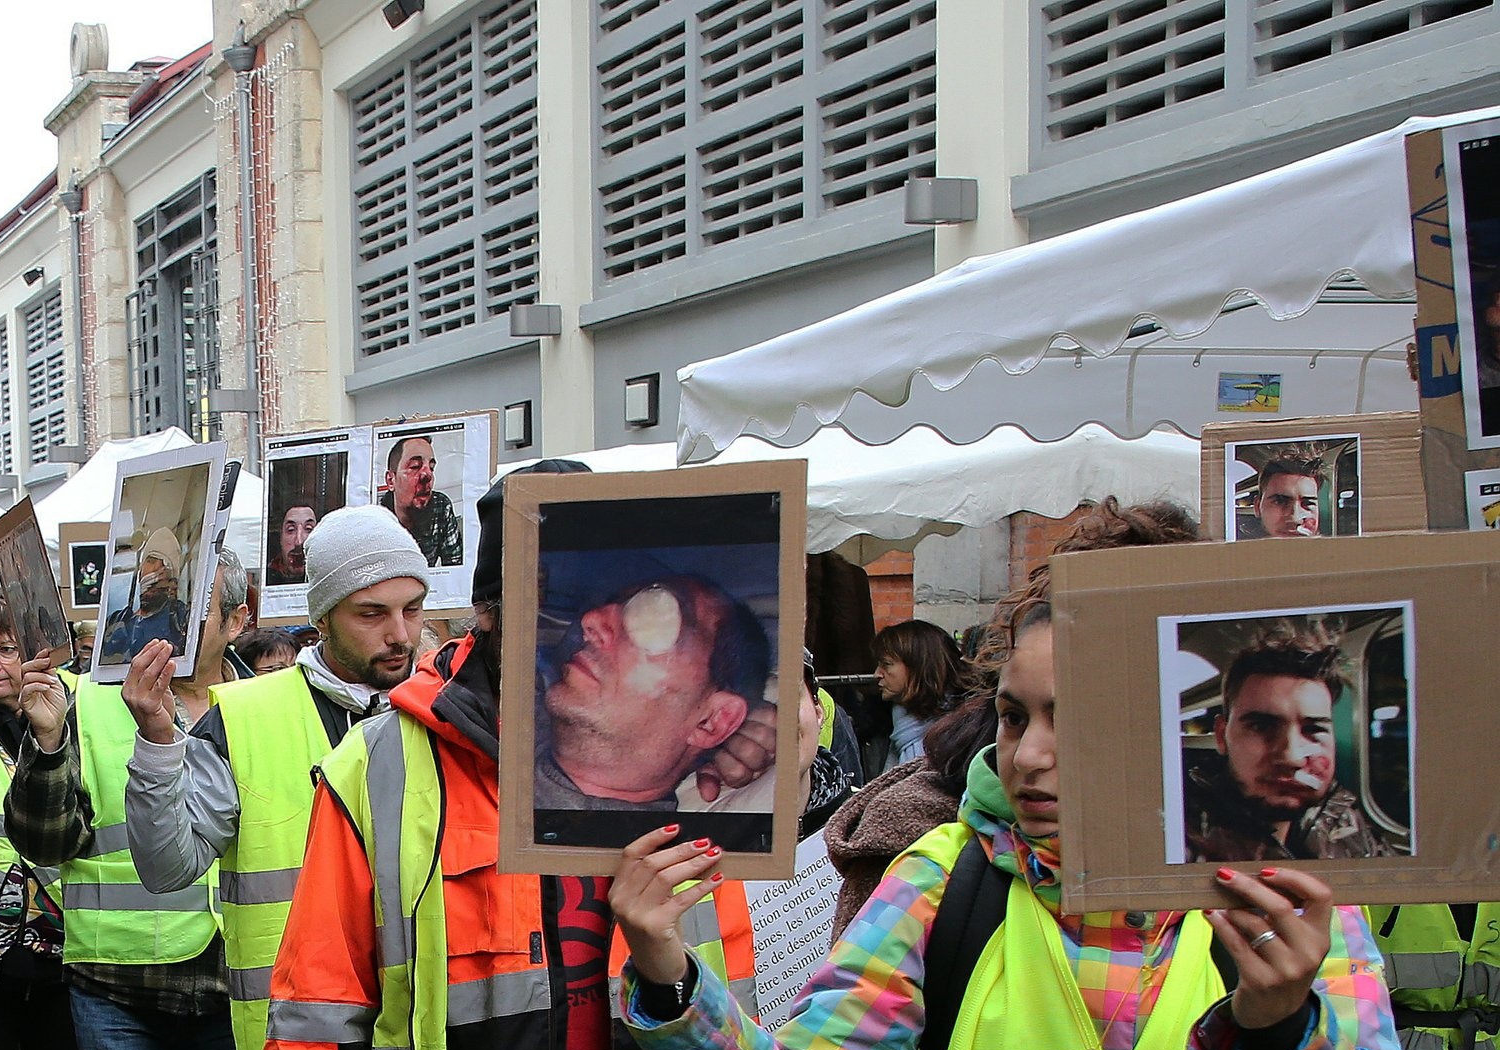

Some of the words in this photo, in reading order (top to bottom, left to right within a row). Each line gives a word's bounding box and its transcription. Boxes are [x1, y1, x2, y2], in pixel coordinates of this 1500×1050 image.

[782, 886, 817, 913] contre
[816, 874, 833, 890] les
[785, 916, 804, 932] les
[804, 897, 831, 920] flash
[758, 975, 780, 995] être
[780, 943, 826, 981] assimilé
[770, 950, 786, 965] de
